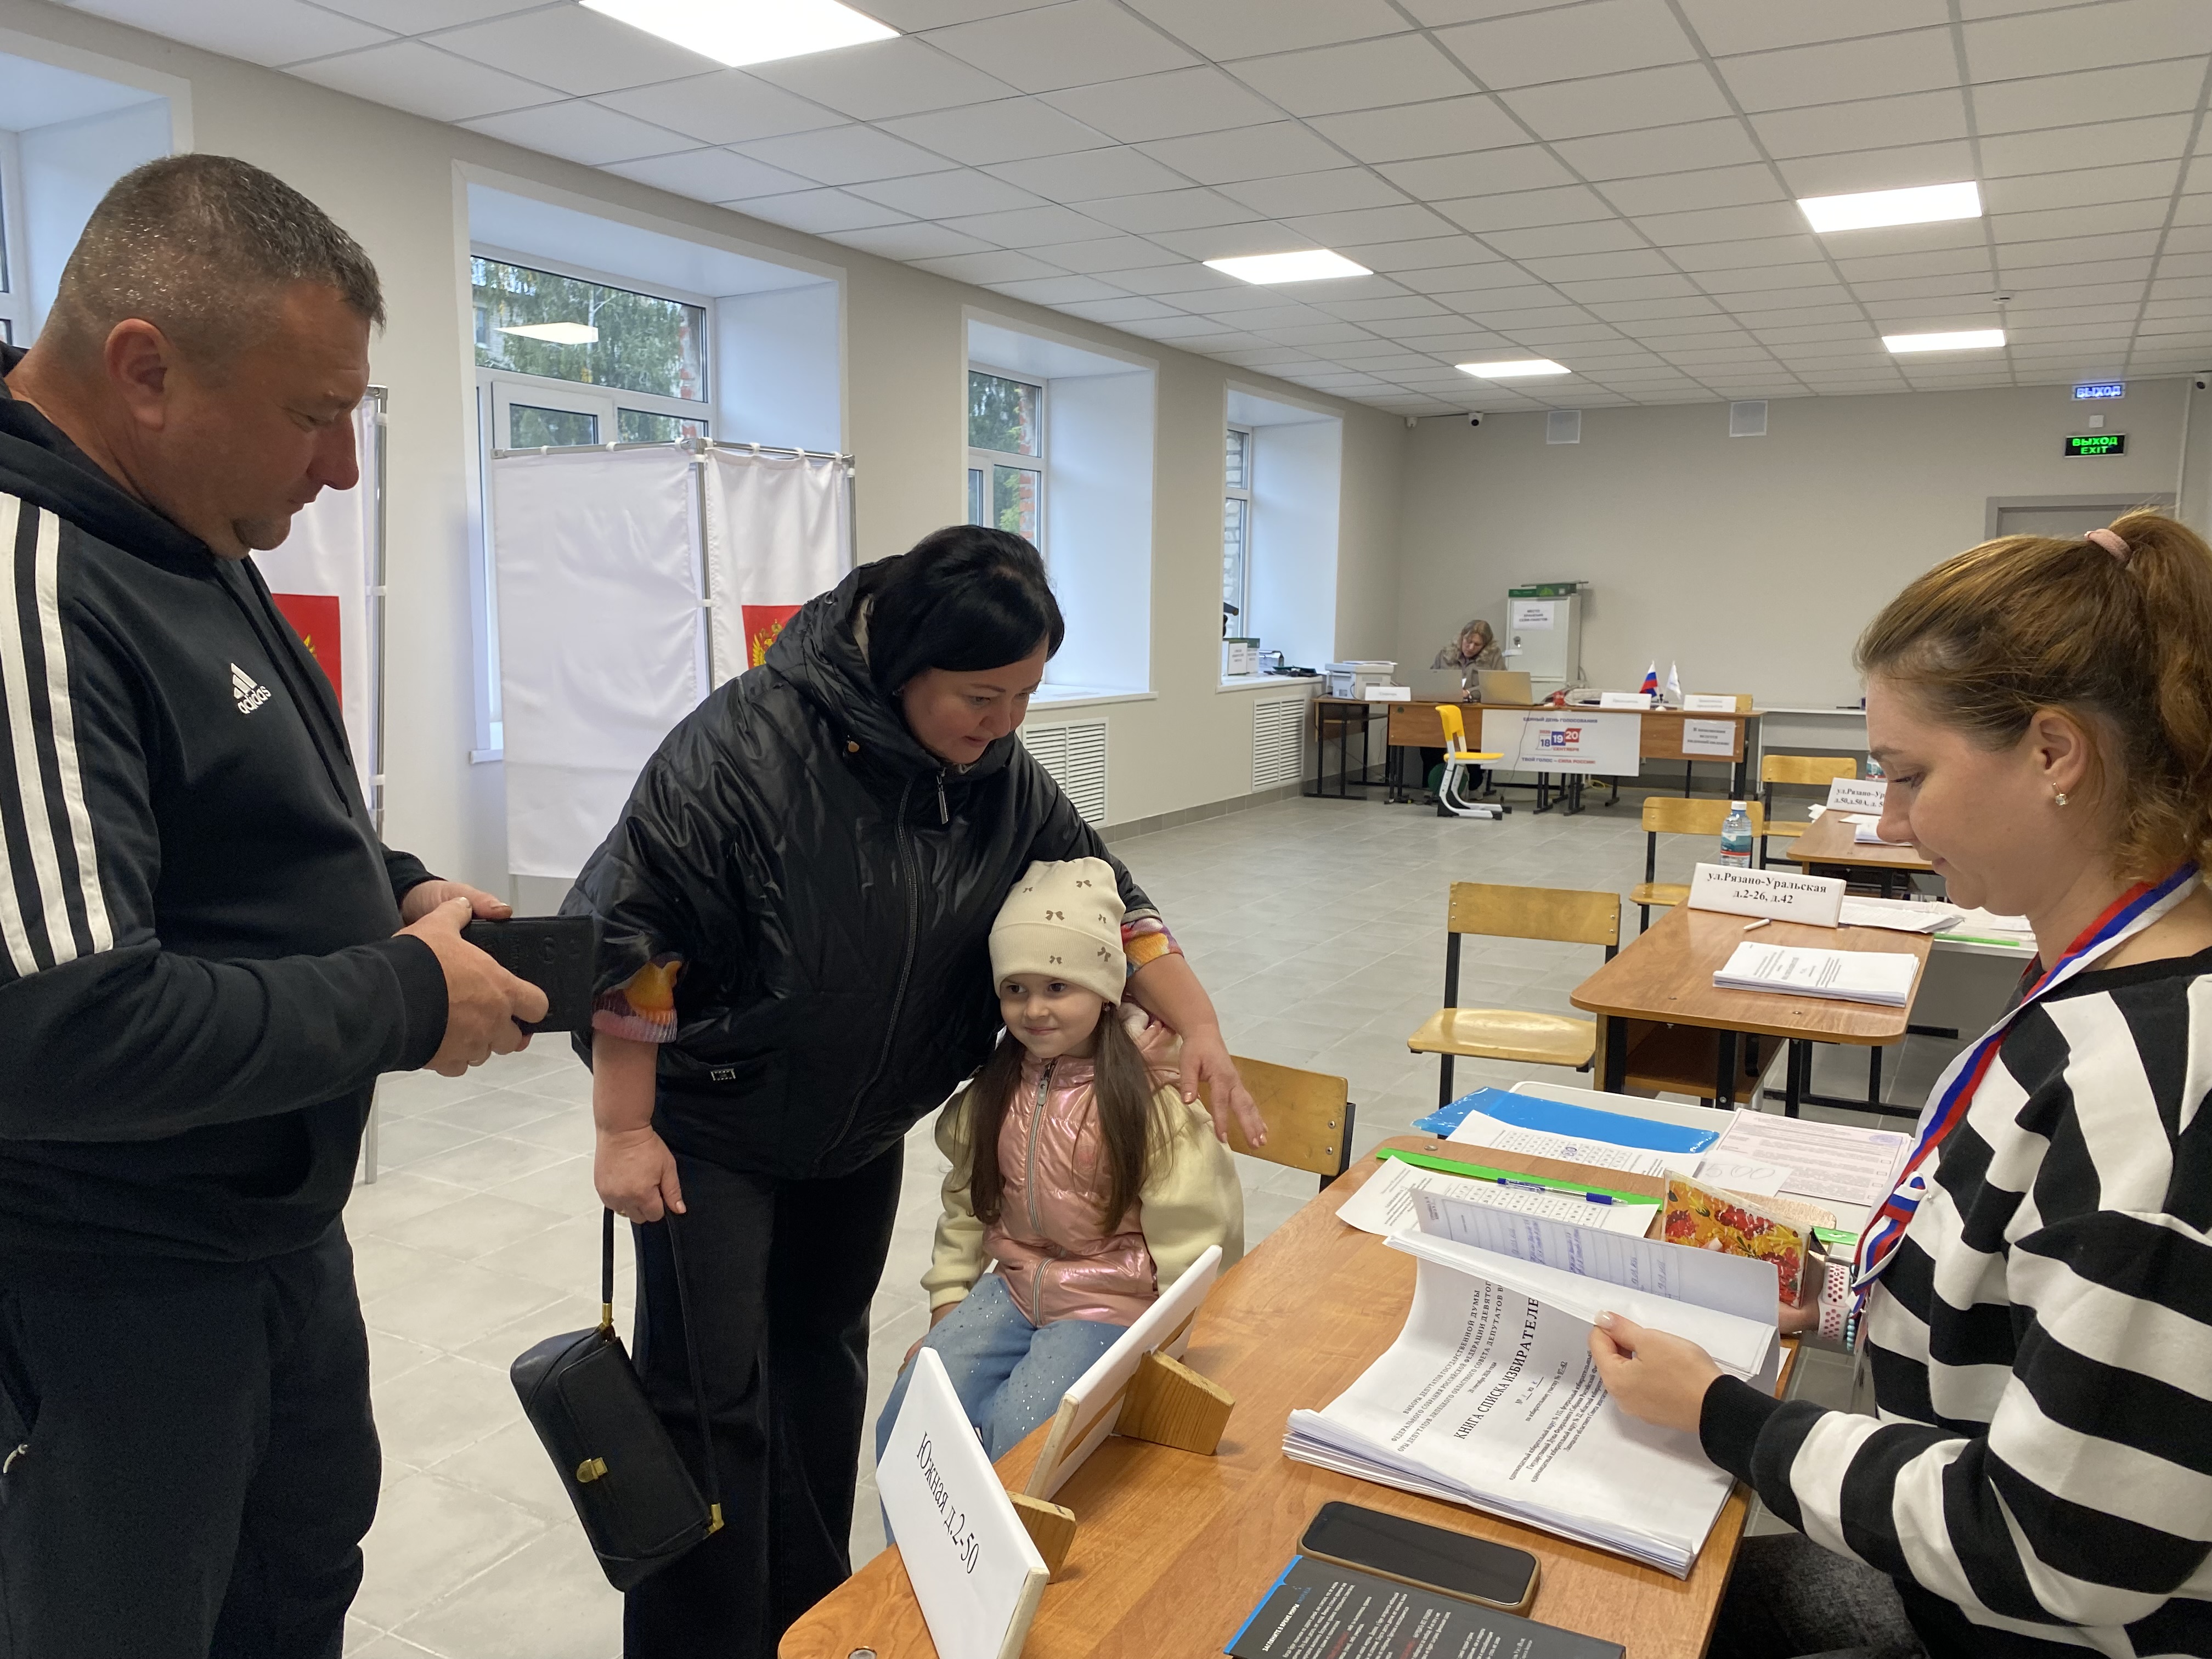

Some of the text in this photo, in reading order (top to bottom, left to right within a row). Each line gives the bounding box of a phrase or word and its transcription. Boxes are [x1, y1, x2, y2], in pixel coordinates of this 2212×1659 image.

[2076, 386, 2121, 398] ВЫХОД
[2073, 437, 2118, 446] ВЫХОД
[238, 686, 272, 714] adidas
[1553, 735, 1564, 743] 19
[1565, 731, 1578, 740] 20
[1707, 872, 1826, 893] ул.Рязано-Уральская
[1733, 889, 1793, 904] д.2-26, д.42
[1391, 1280, 1492, 1442] ФЕДЕРАЛЬНОГО СОБРАНИЯ РОССИЙСКОЙ ФЕДЕРАЦИИ ДЕВЯТОГ
[1403, 1290, 1480, 1414] ВЫБОРЫ ДЕПУТАТОВ ГОСУДАРСТВЕННОЙ ДУМЫ
[1407, 1418, 1432, 1444] ДЕПУТАТОВ
[1430, 1393, 1454, 1418] ЛИПЕЦКОГО
[1451, 1368, 1477, 1395] ОБЛАСТНОГО
[1474, 1348, 1490, 1369] СОВЕТА
[1486, 1295, 1503, 1346] ДЕПУТАТОВ
[1453, 1297, 1539, 1439] КНИГА СПИСКА ИЗБИРАТЕЛЕ
[916, 1430, 980, 1574] Южная д.2-50
[1262, 1628, 1282, 1652] ЗАГЛЯНИТЕ
[1280, 1615, 1292, 1628] ЯРКИЕ
[1288, 1603, 1300, 1616] МИРЫ
